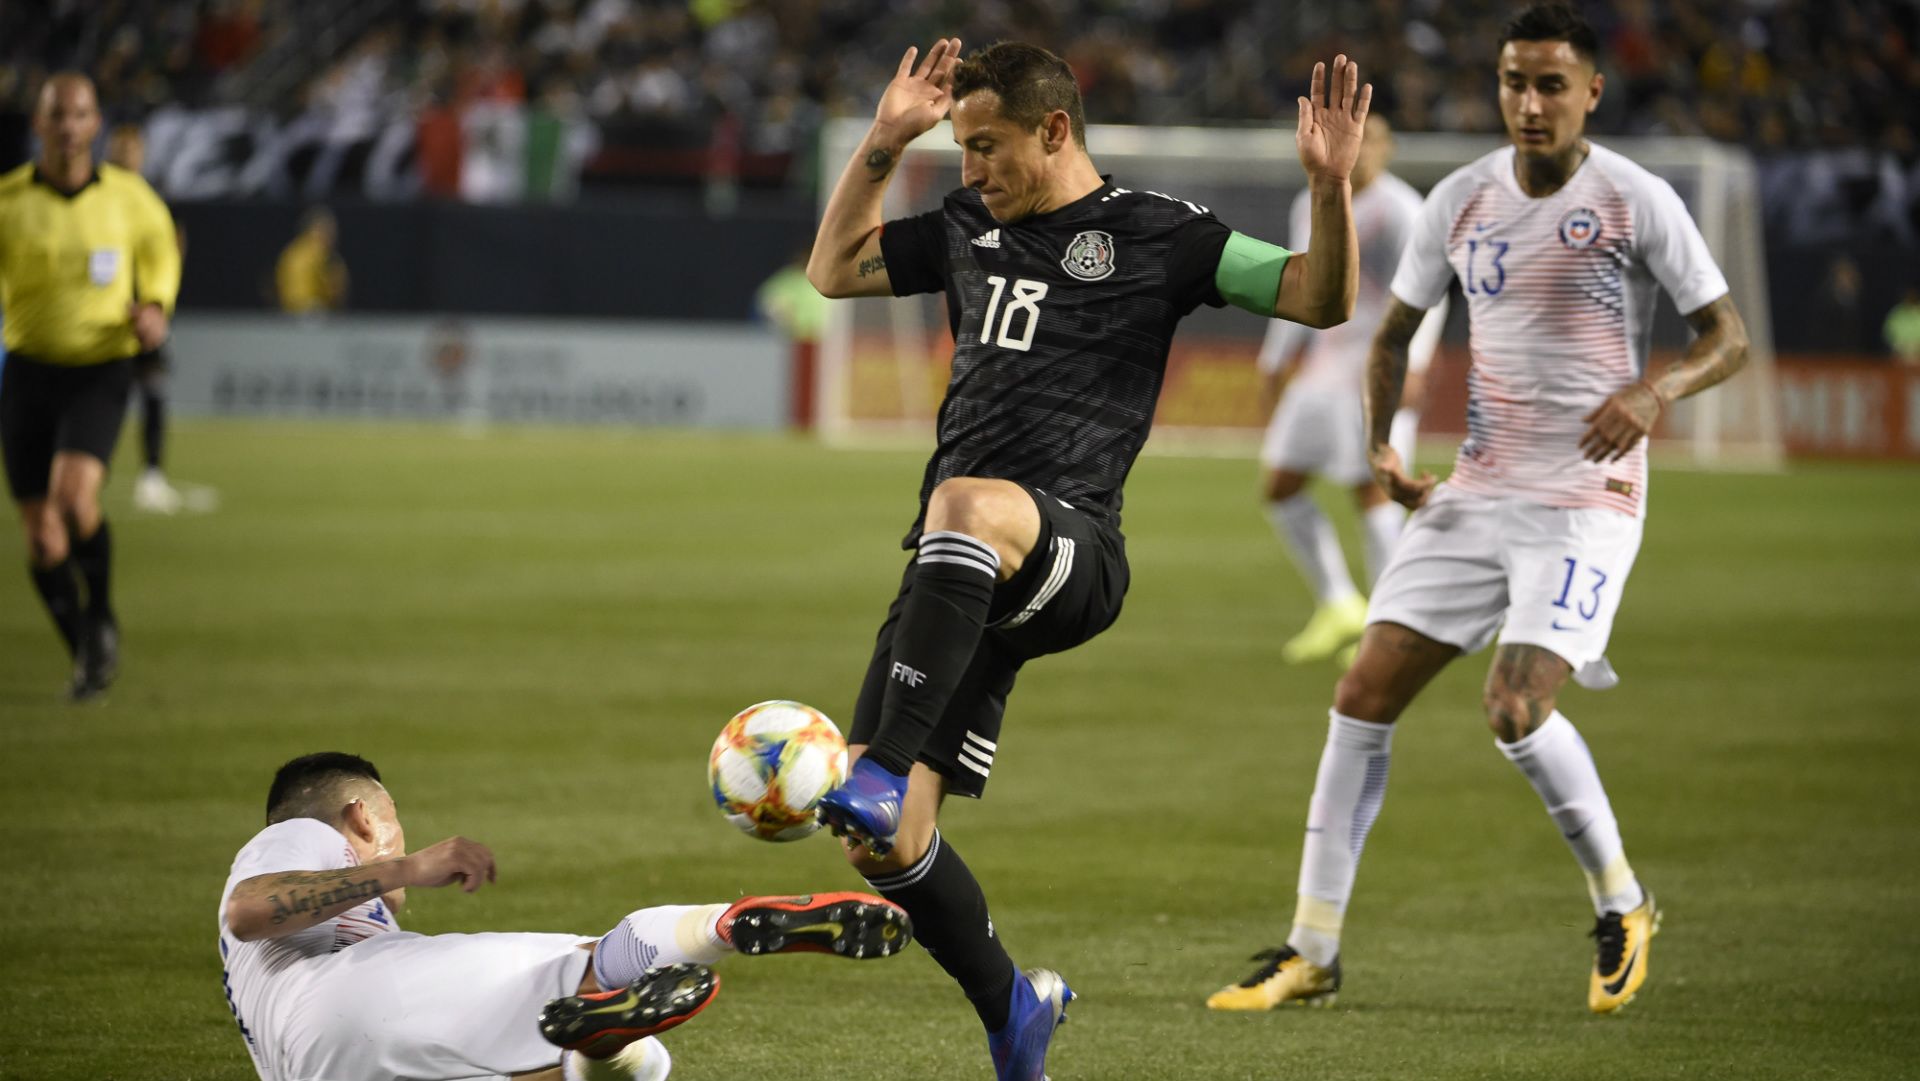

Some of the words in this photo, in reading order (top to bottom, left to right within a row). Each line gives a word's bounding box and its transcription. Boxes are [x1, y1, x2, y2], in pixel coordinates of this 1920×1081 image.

[1467, 239, 1510, 296] 13
[980, 275, 1049, 352] 18
[1552, 556, 1607, 620] 13
[891, 661, 928, 688] FMF
[266, 878, 384, 924] Alejandra
